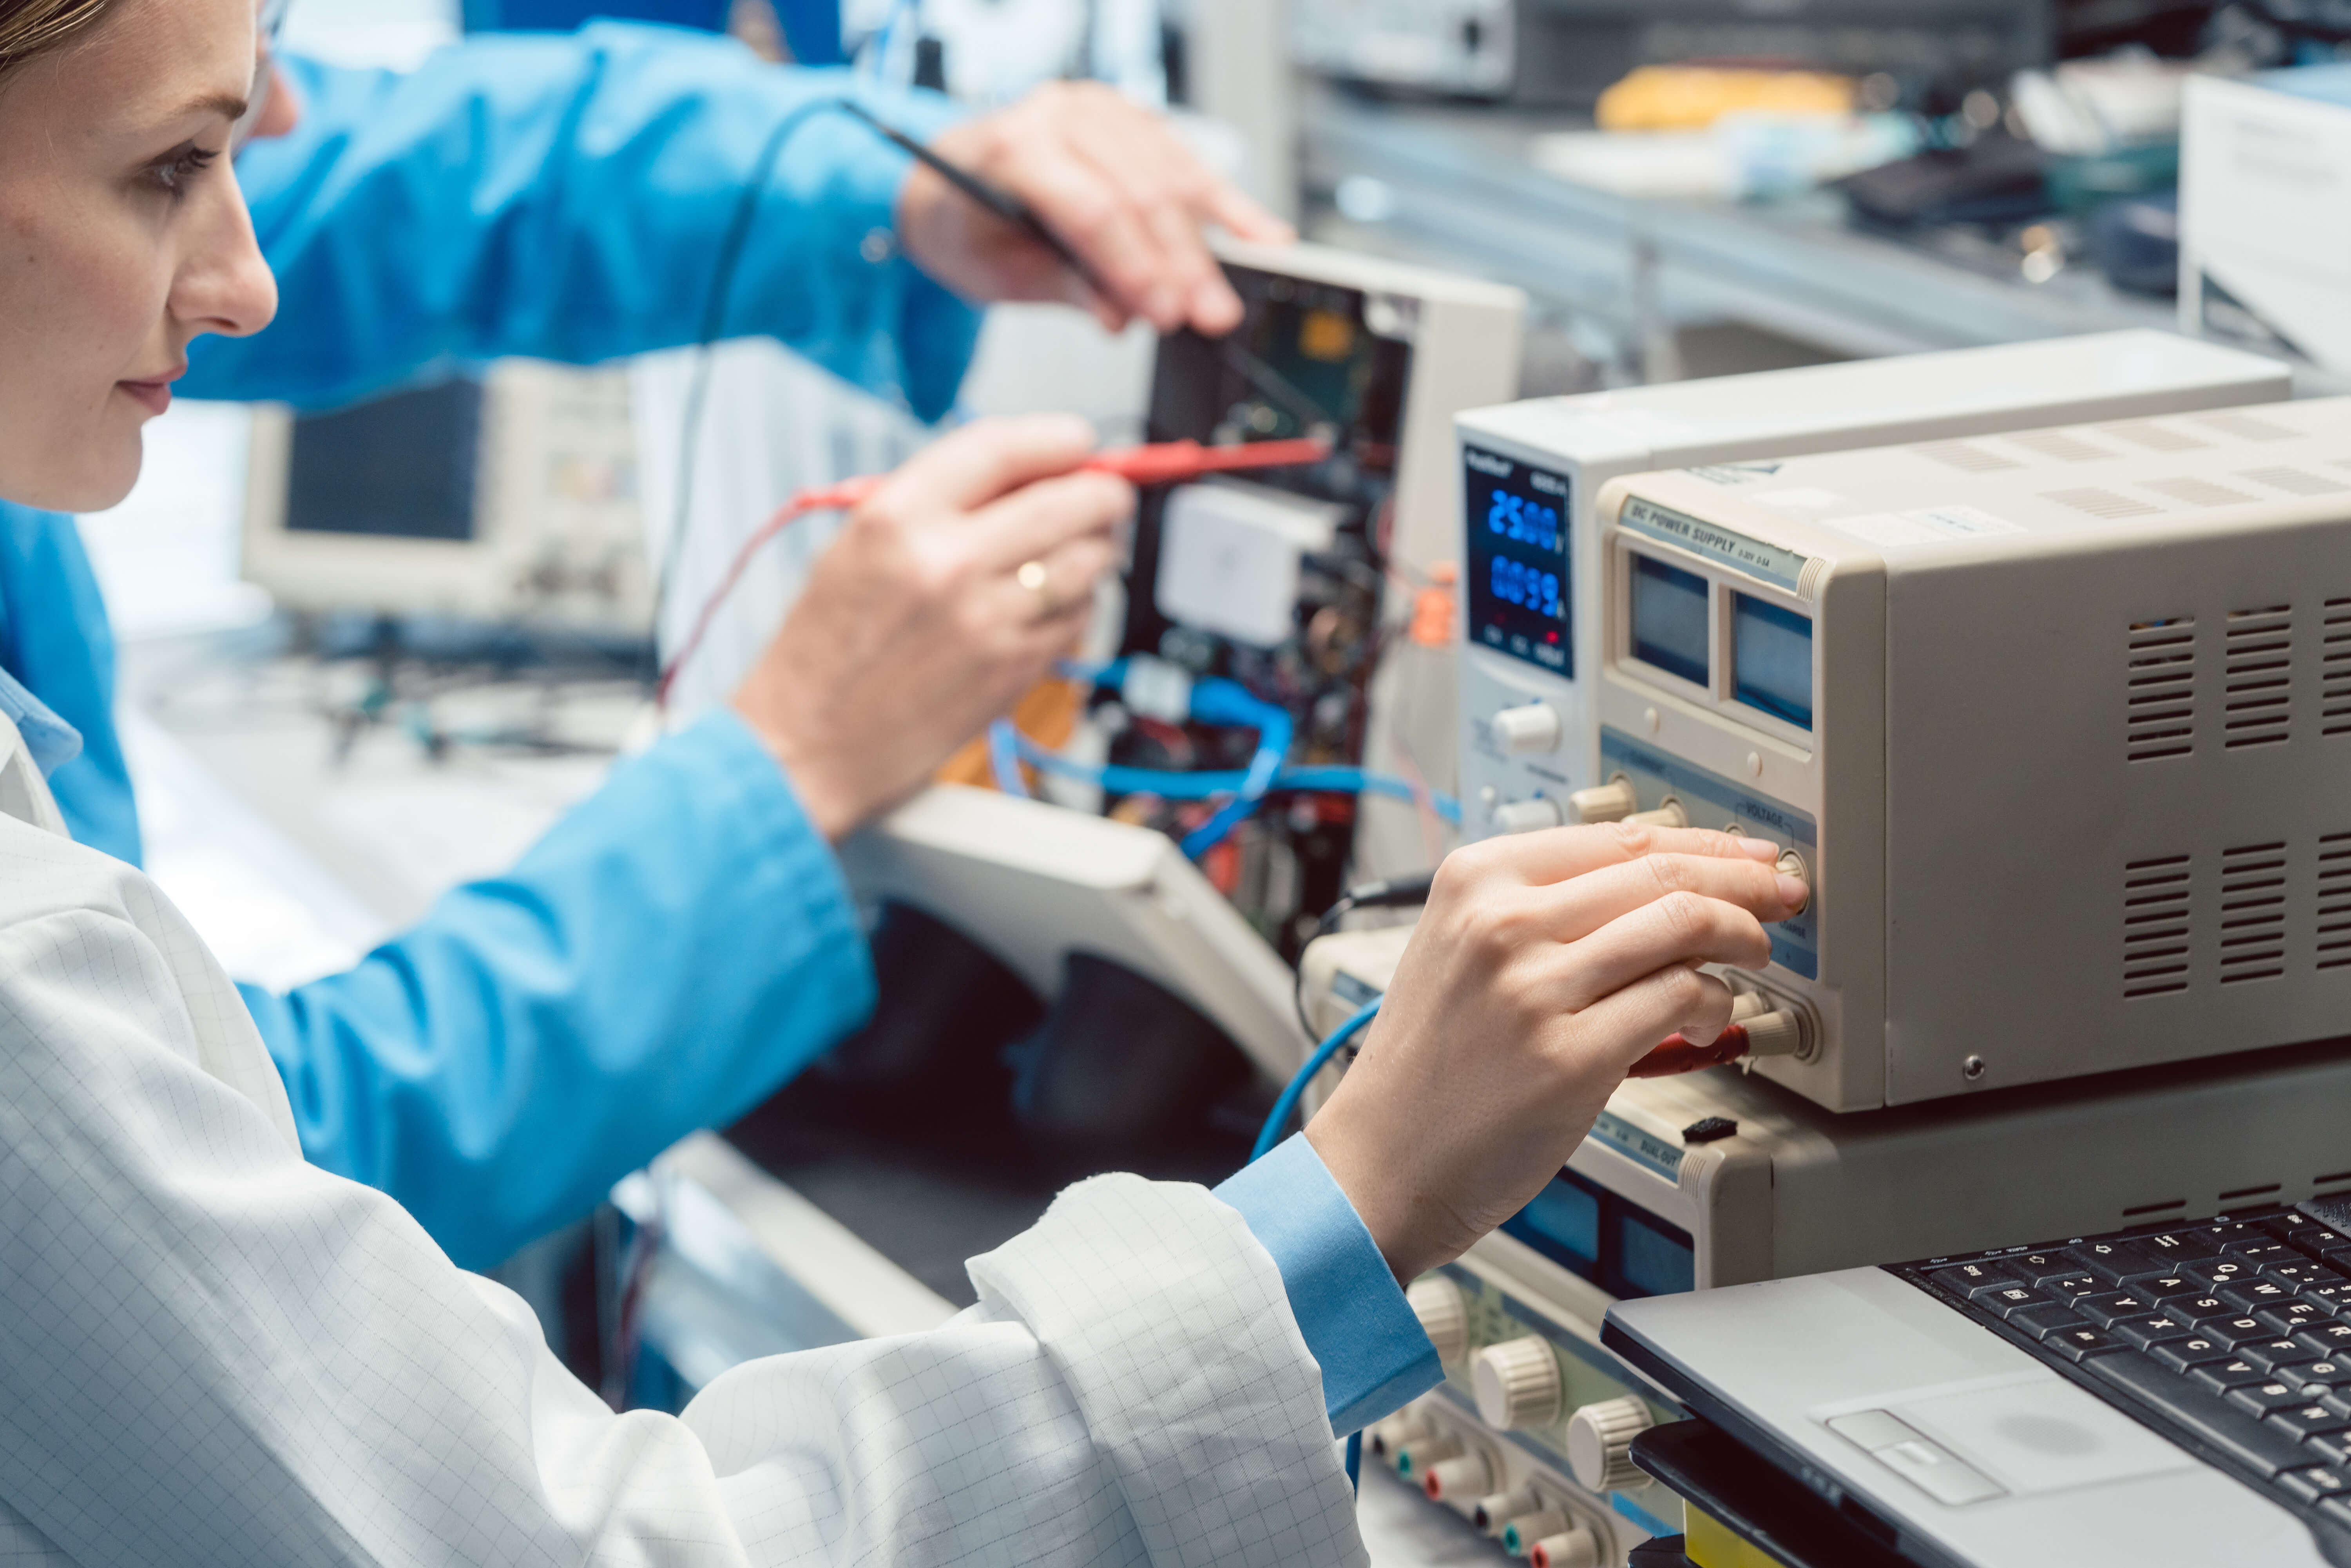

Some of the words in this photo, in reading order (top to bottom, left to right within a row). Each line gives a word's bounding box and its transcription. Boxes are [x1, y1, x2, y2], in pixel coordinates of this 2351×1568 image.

[1632, 504, 1647, 520] DC
[1649, 511, 1690, 536] POWER
[1692, 527, 1736, 553] SUPPLY
[1746, 802, 1783, 829] VOLTAGE
[2218, 1264, 2238, 1273] Q
[2255, 1284, 2281, 1294] W
[2290, 1304, 2314, 1313] E
[2148, 1319, 2174, 1329] X
[2233, 1319, 2256, 1328] D
[2328, 1326, 2351, 1336] R
[2188, 1340, 2210, 1350] C
[2227, 1362, 2251, 1371] V
[2312, 1363, 2336, 1373] G
[2262, 1384, 2288, 1395] B
[2302, 1407, 2329, 1419] N
